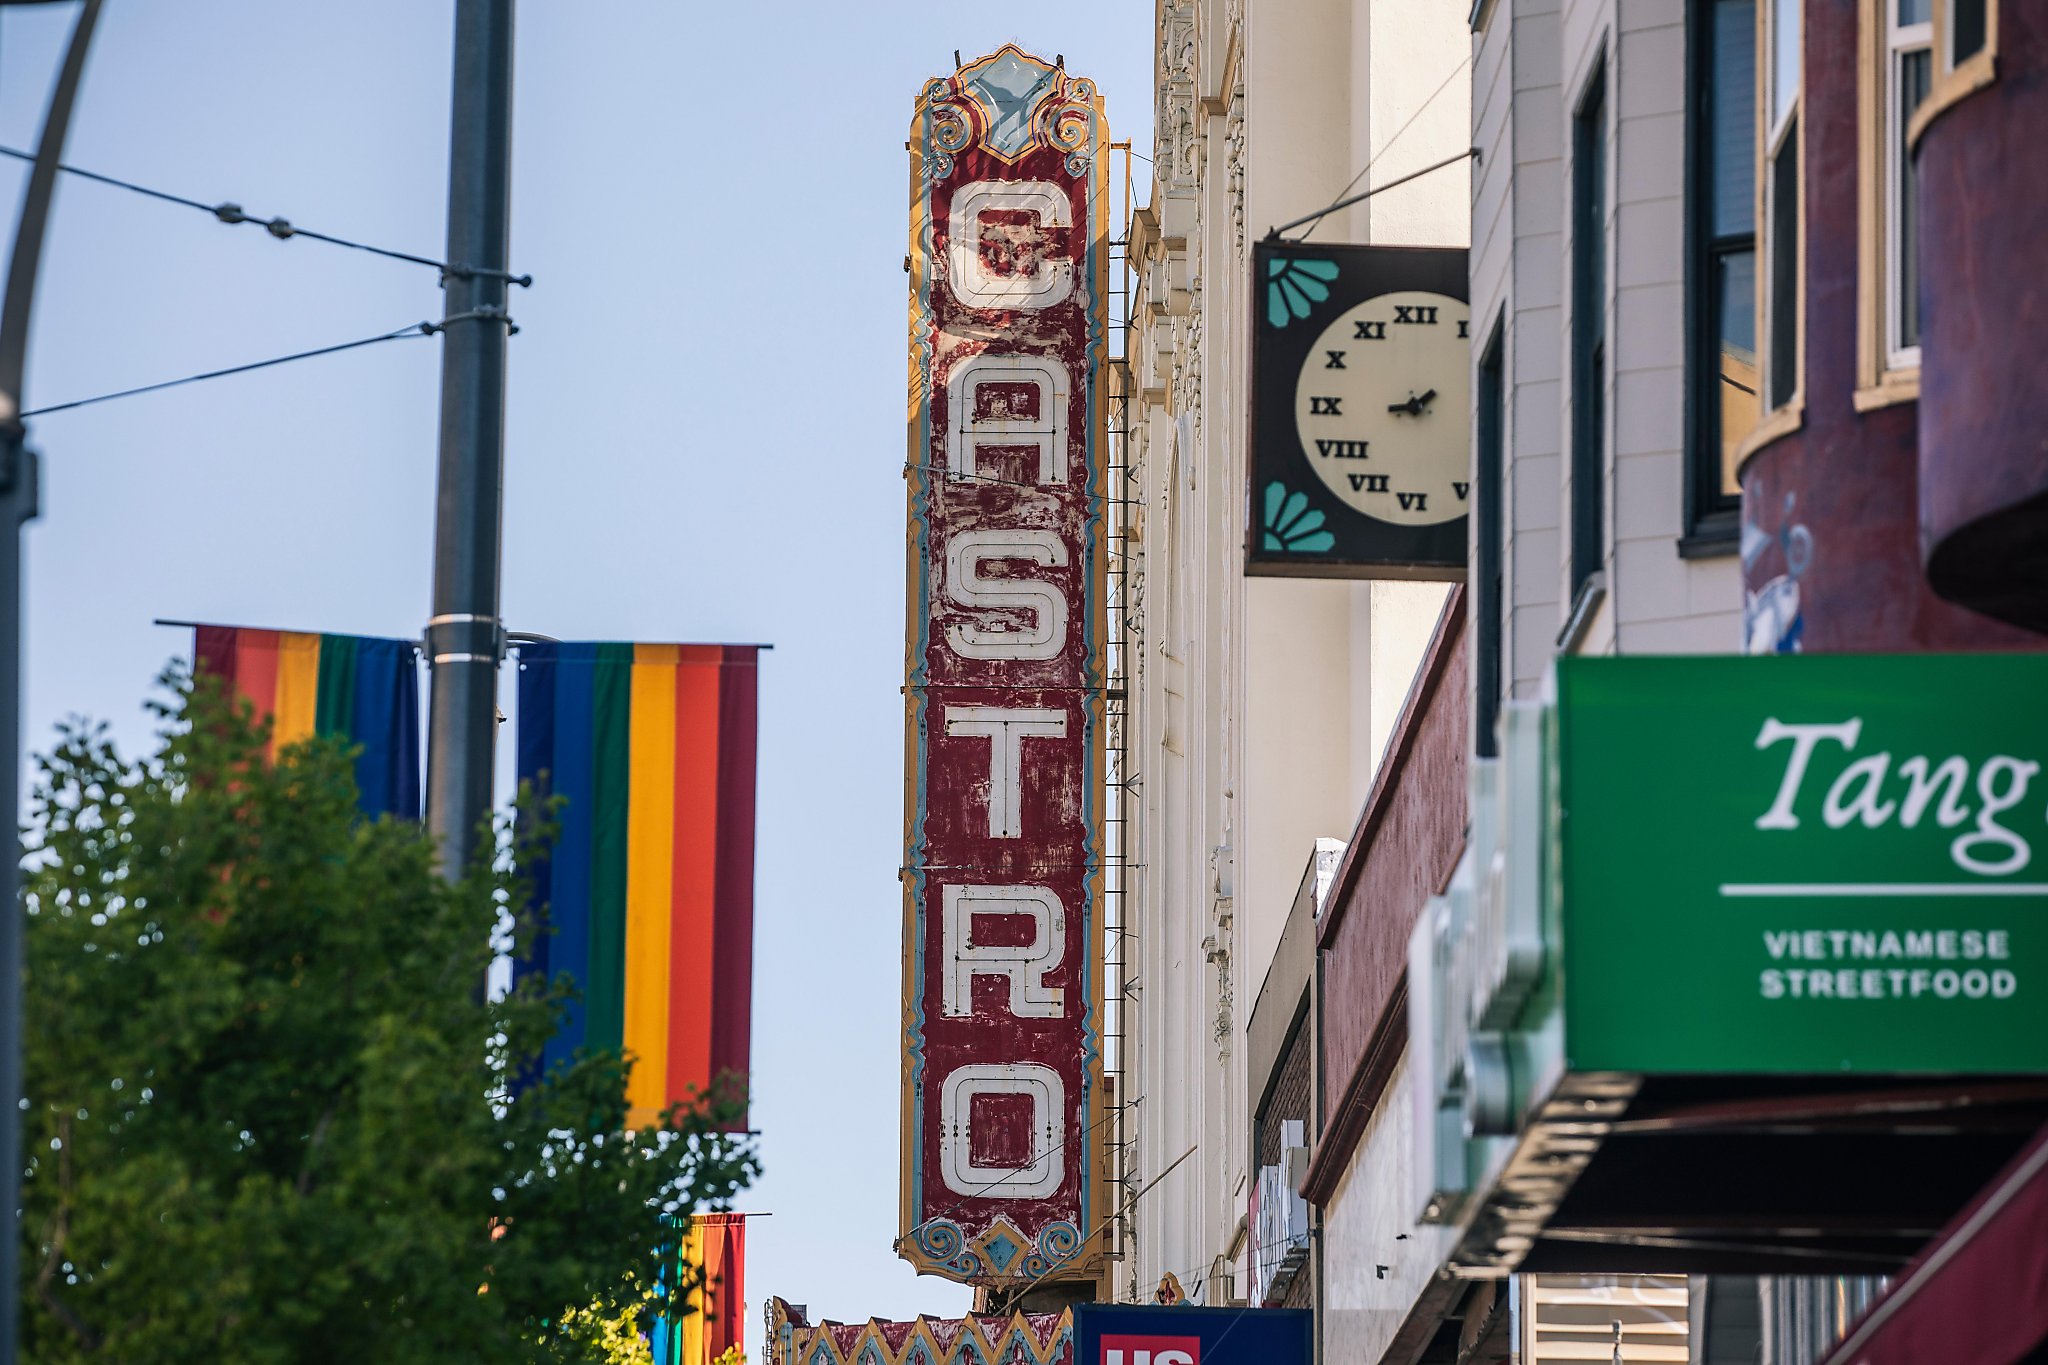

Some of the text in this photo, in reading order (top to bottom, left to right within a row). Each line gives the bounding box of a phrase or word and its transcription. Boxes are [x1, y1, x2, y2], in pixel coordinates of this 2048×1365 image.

[1394, 306, 1438, 324] XII
[1354, 321, 1386, 339] XI
[1325, 351, 1347, 369] X
[1310, 397, 1342, 415] IX
[1316, 439, 1369, 459] VIII
[1347, 473, 1390, 493] VII
[1397, 493, 1427, 512] VI
[940, 178, 1075, 1201] CASTRO
[1754, 716, 2041, 876] Tang
[1763, 929, 2011, 960] VIETNAMESE
[1759, 969, 2017, 999] STREETFOOD
